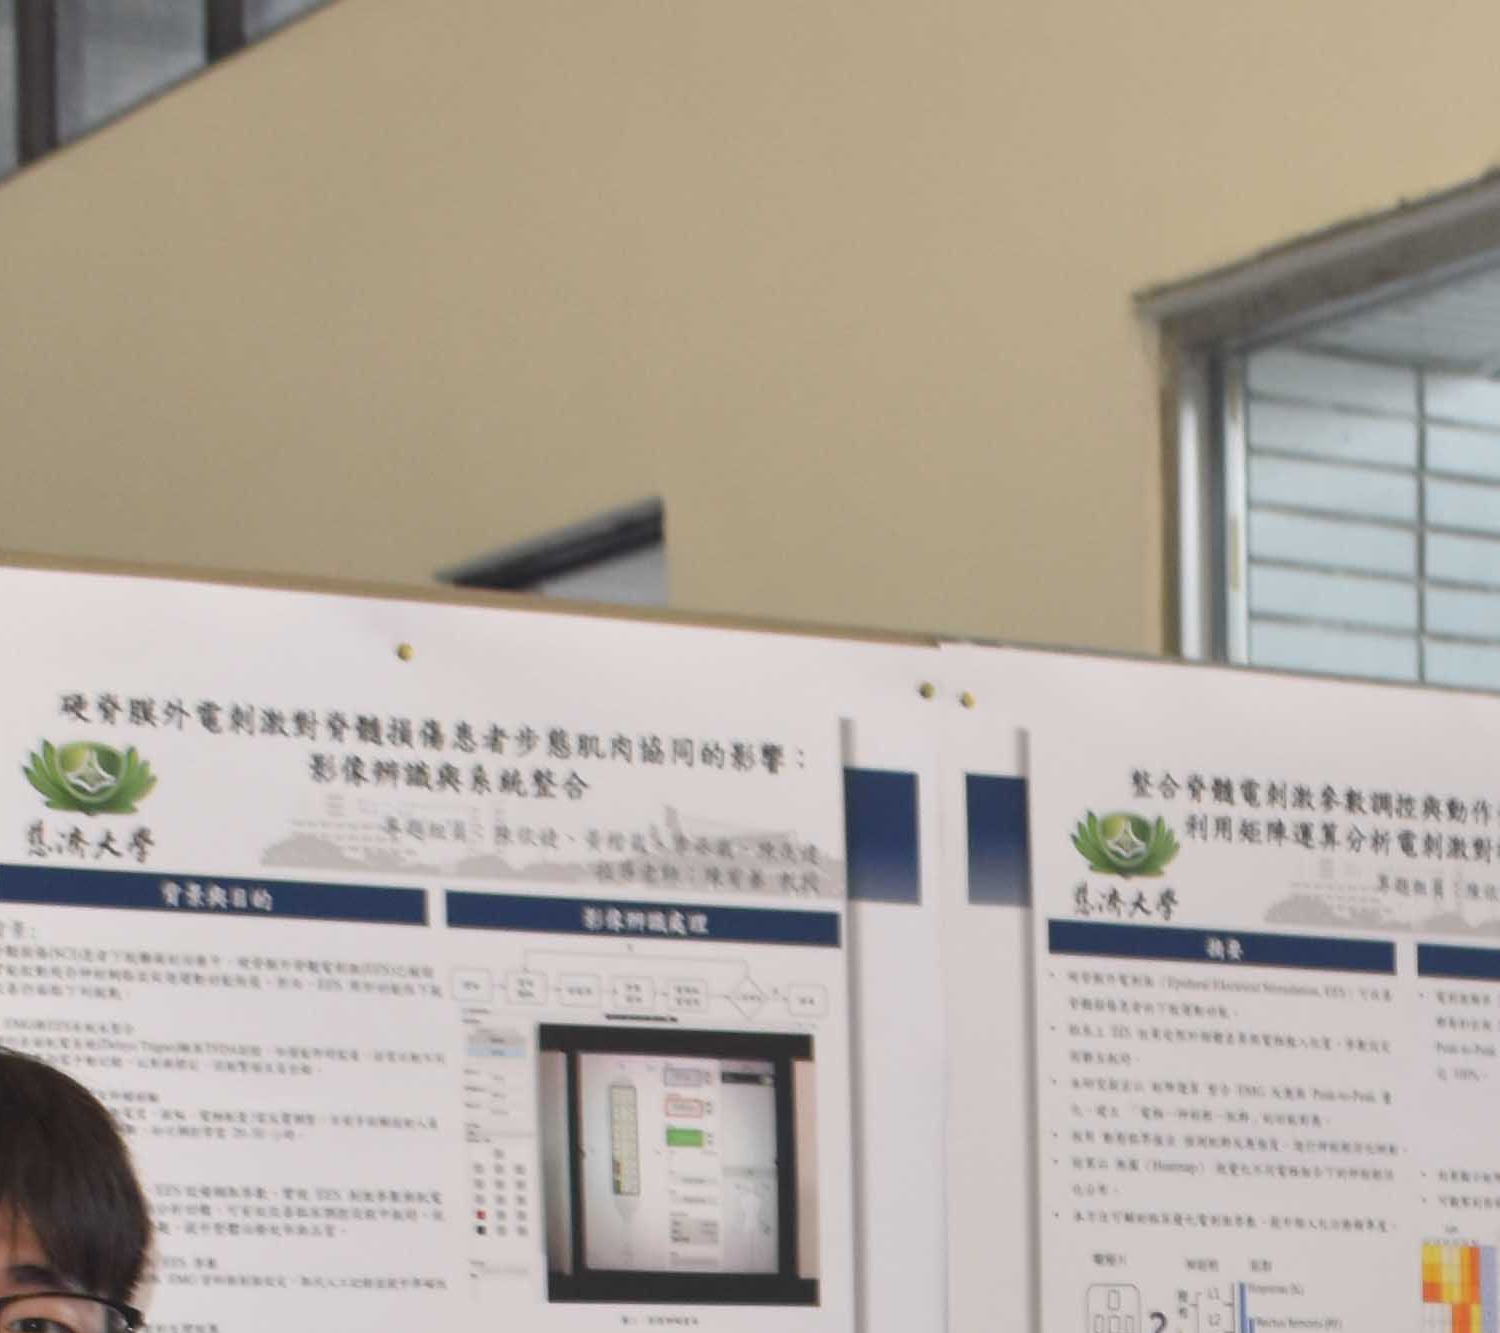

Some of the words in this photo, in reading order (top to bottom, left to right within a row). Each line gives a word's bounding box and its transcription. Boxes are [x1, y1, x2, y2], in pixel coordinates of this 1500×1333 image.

[25, 818, 157, 864] 慈濟大學
[1071, 882, 1179, 921] 慈濟大學
